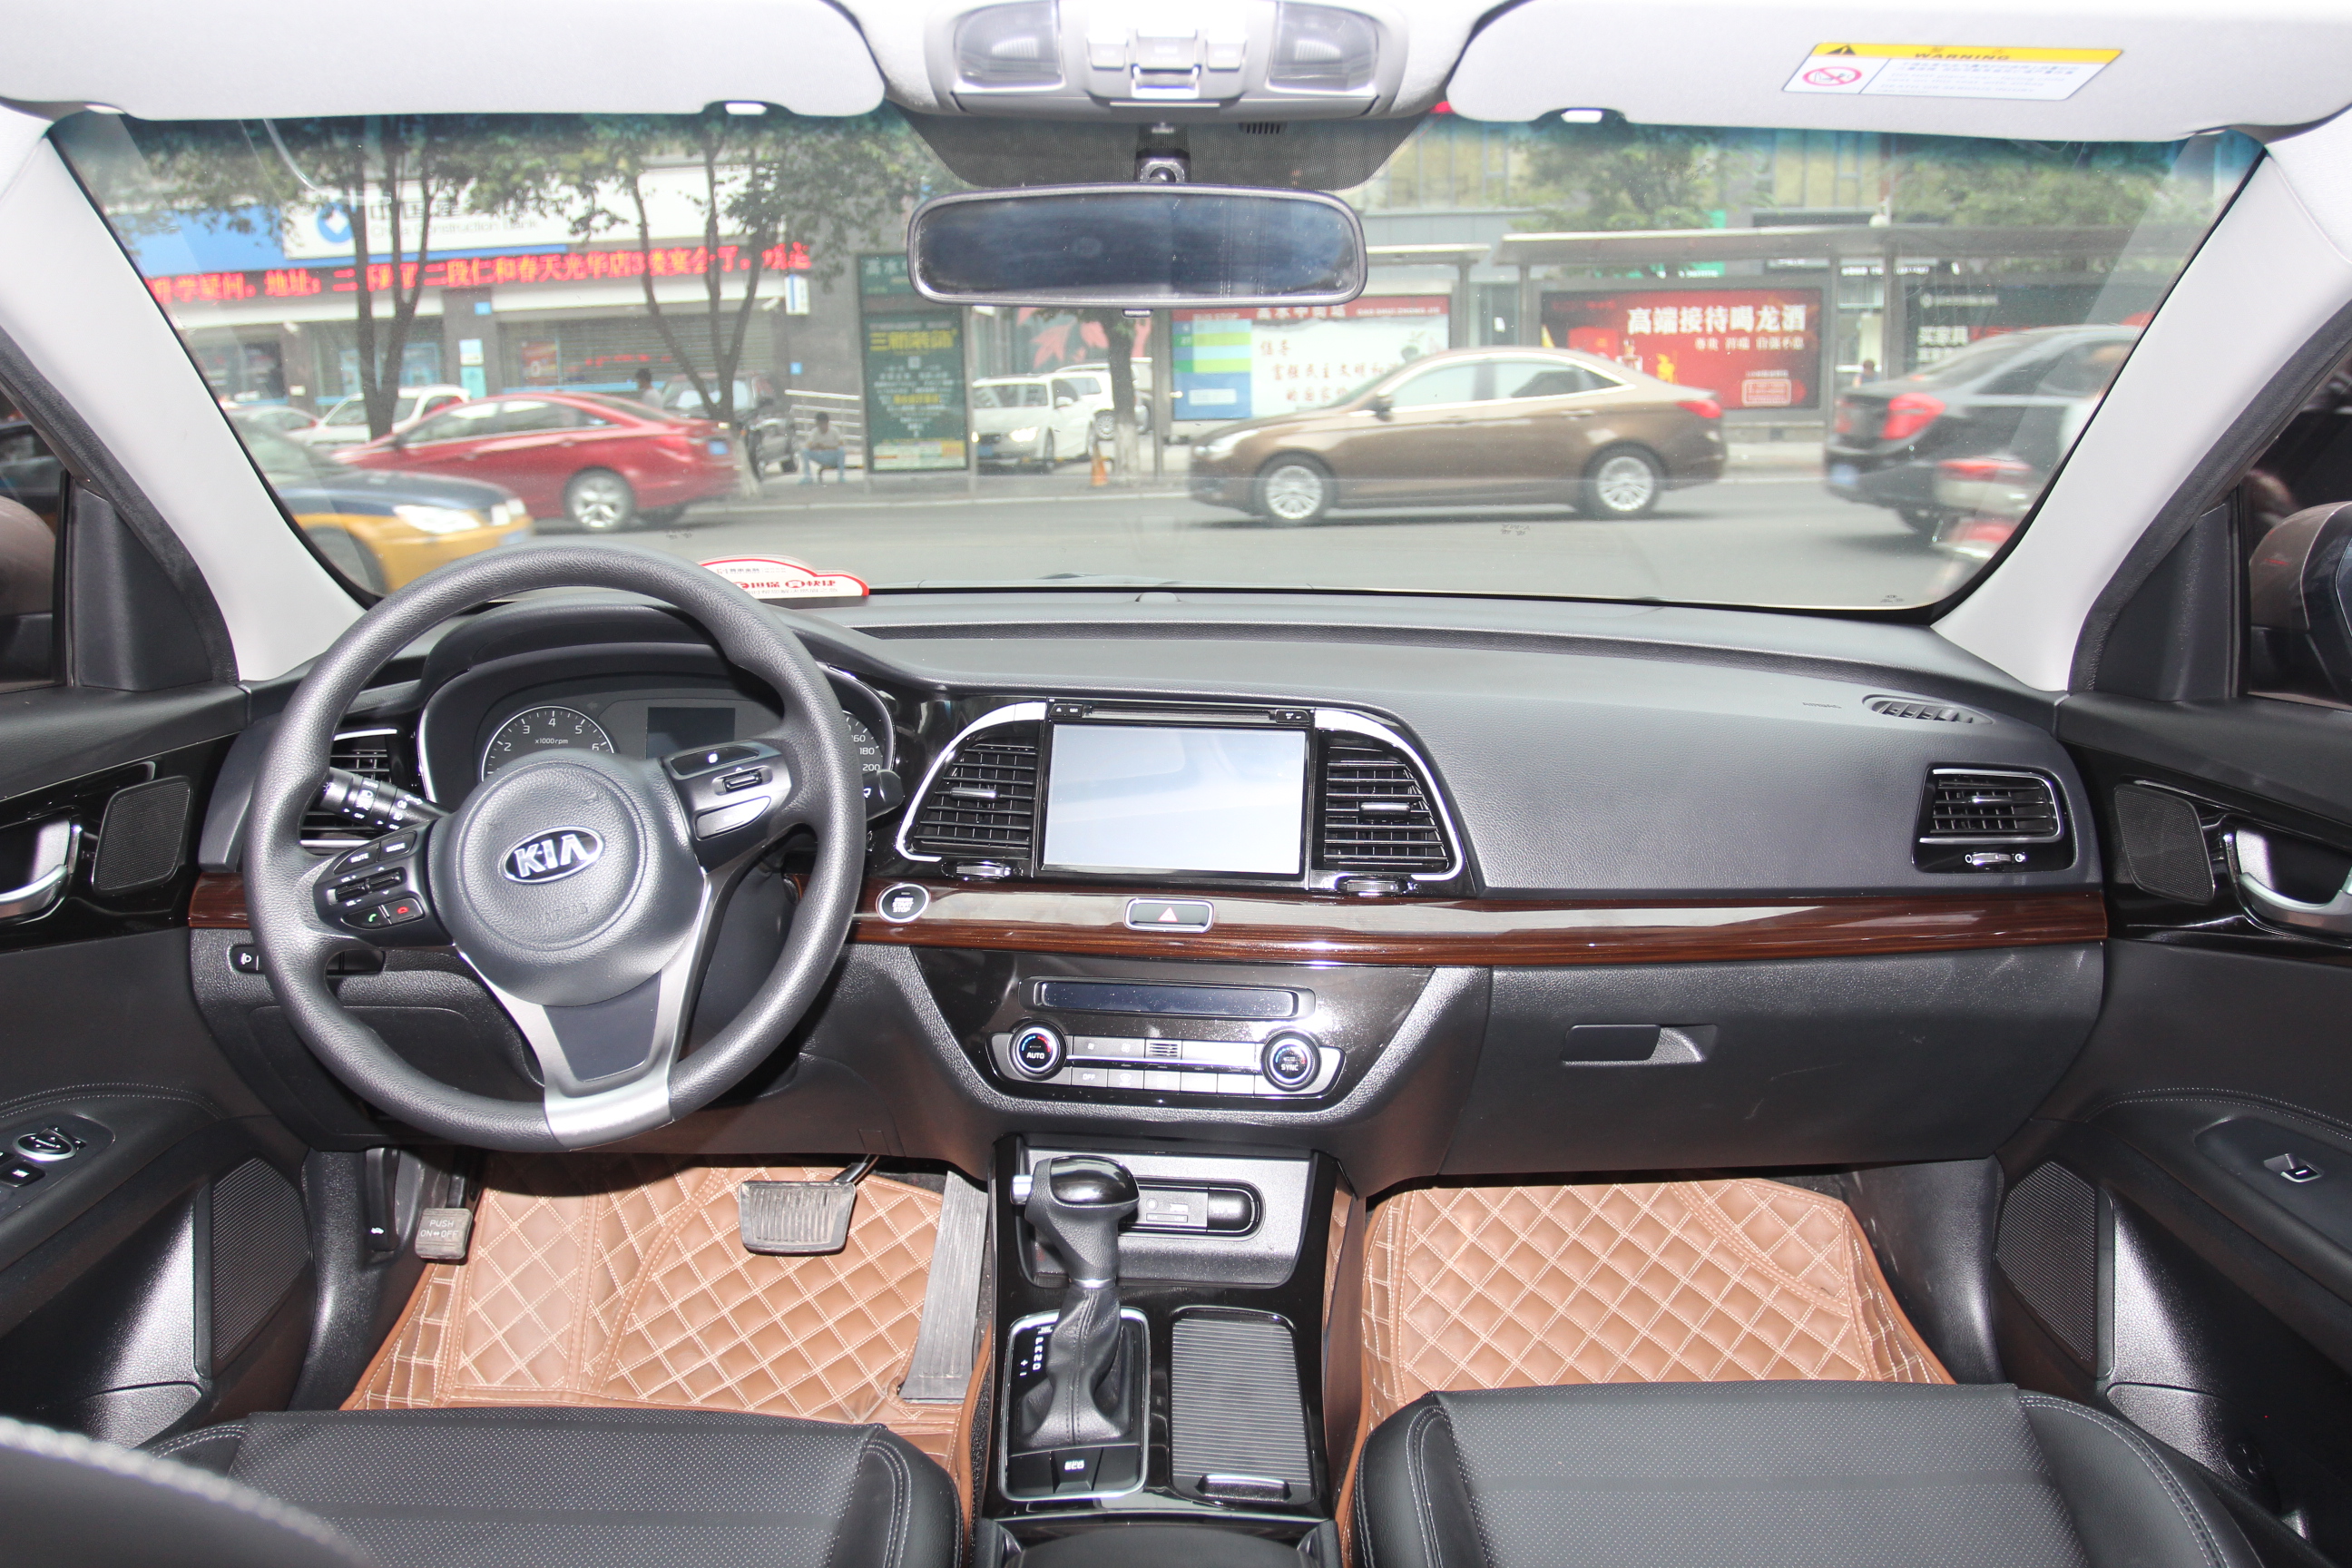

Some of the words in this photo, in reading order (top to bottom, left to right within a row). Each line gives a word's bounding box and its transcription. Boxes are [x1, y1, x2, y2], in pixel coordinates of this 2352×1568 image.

[1915, 53, 2011, 61] WARNING
[1627, 304, 1807, 336] 高端接待喝龙酒
[548, 718, 556, 727] 4
[523, 725, 531, 734] 3
[574, 725, 583, 734] 5
[851, 734, 866, 742] 60
[504, 741, 512, 752] 2
[858, 747, 876, 755] 180
[862, 763, 881, 771] 200
[386, 842, 406, 853] MODE
[350, 852, 369, 864] MUTE
[514, 833, 591, 877] KIA
[1026, 1052, 1045, 1060] AUTO
[1280, 1063, 1299, 1072] SYNC
[429, 1219, 455, 1228] PUSH
[420, 1230, 433, 1238] ON
[440, 1230, 459, 1238] OFF
[1035, 1337, 1044, 1345] P
[1032, 1362, 1042, 1371] D
